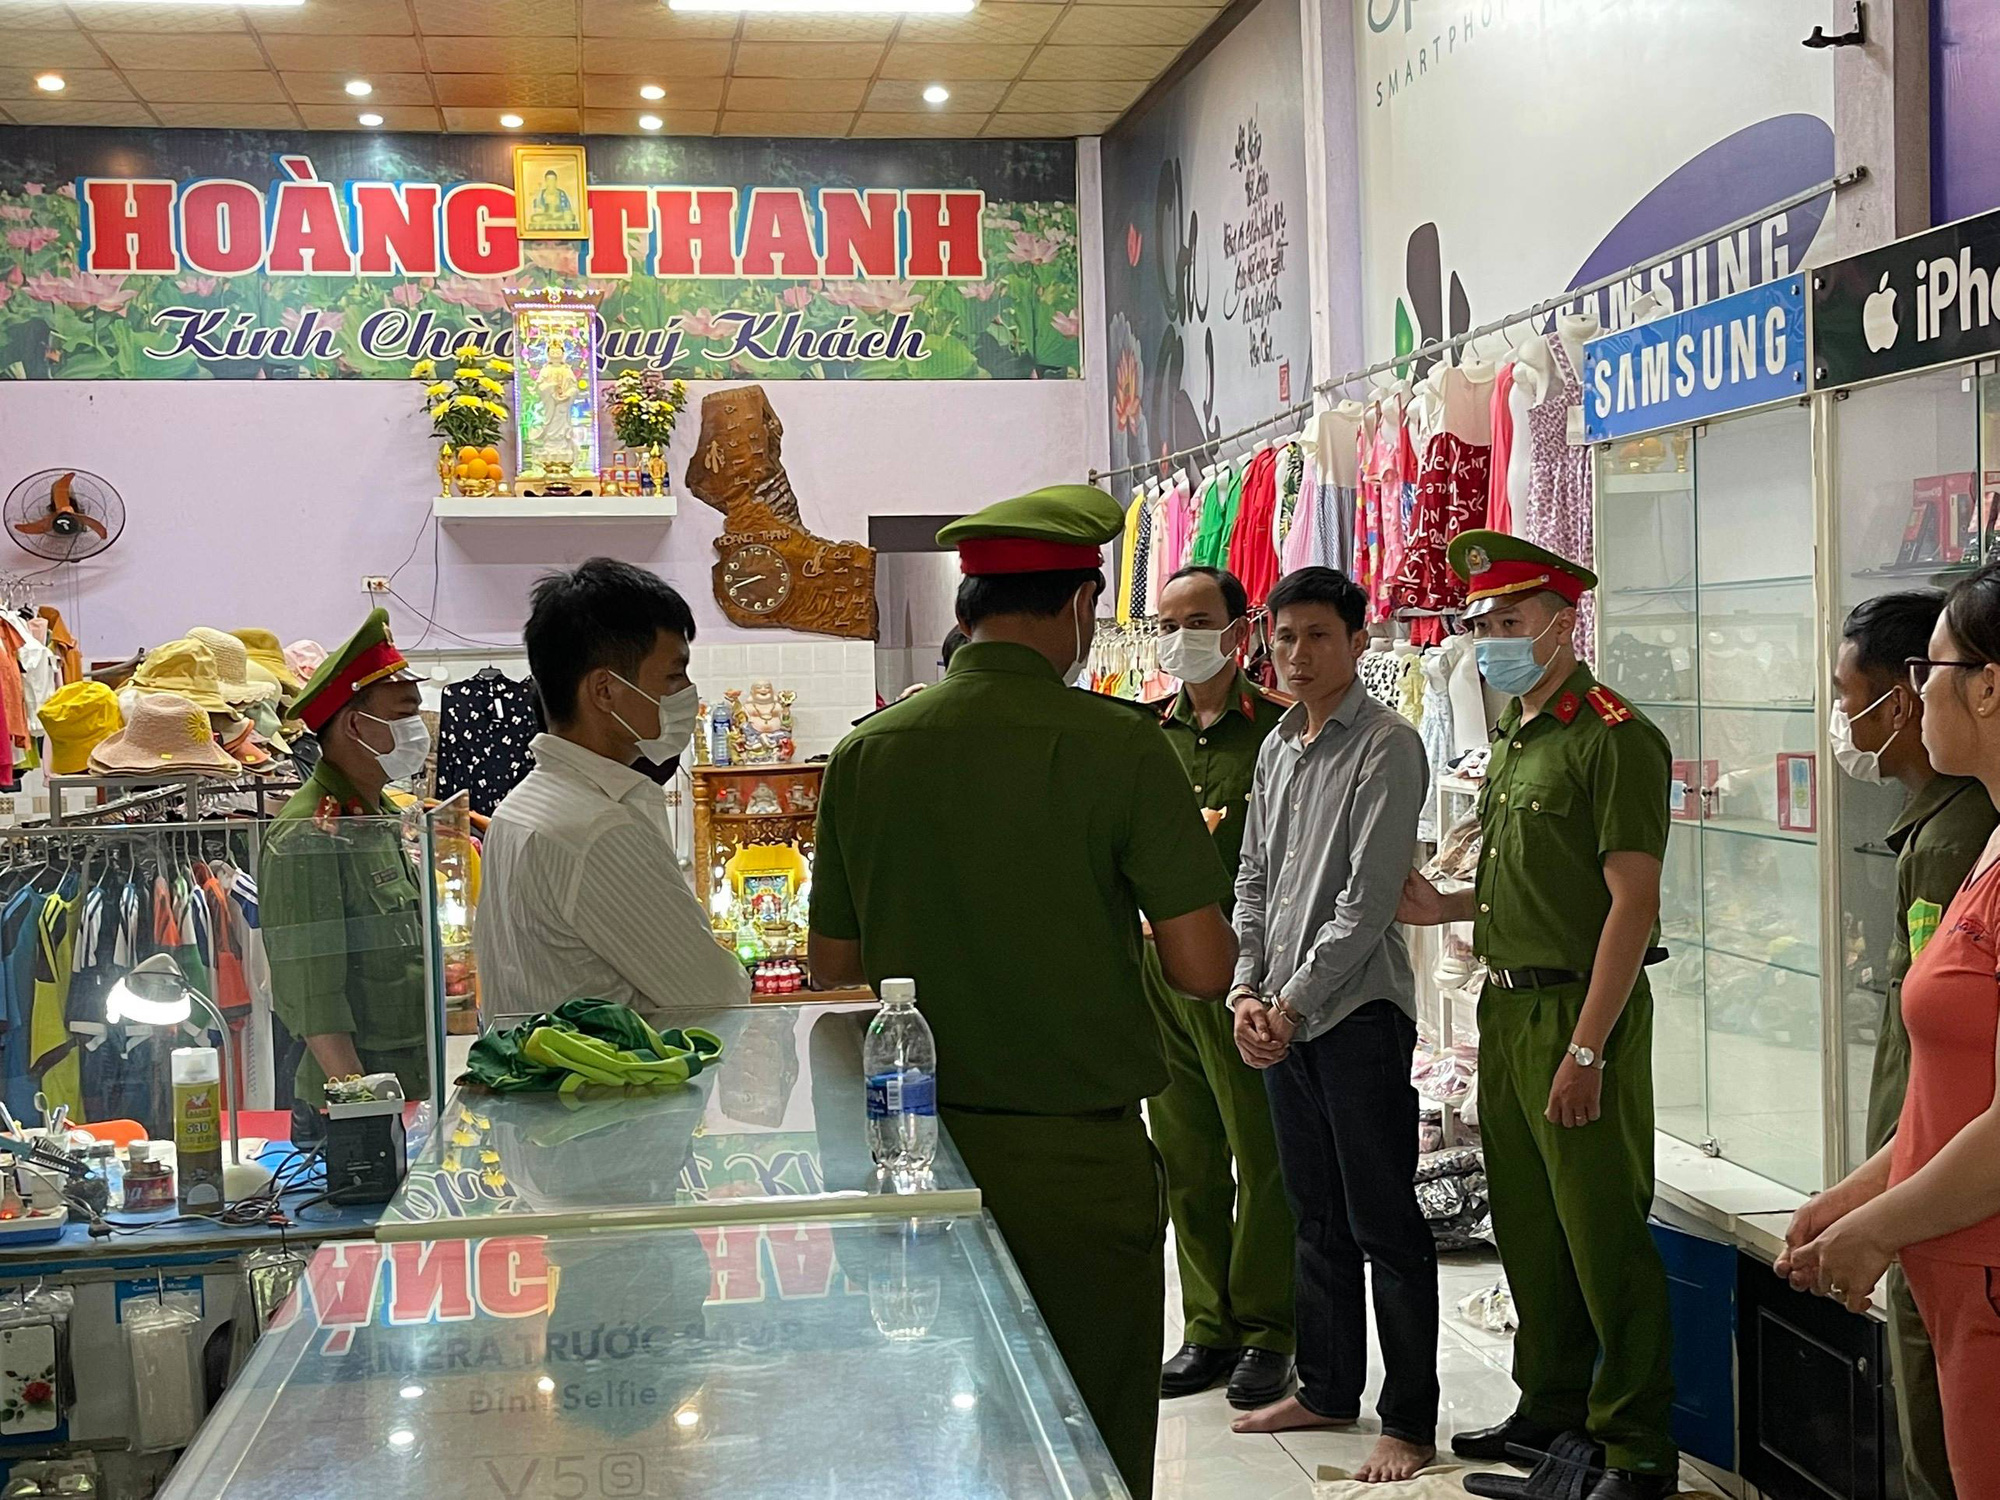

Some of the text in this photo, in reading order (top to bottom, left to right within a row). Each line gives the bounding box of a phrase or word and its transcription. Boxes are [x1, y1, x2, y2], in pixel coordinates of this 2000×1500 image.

[82, 153, 987, 280] HOÀNG THANH
[1916, 246, 2000, 342] iPh
[144, 306, 342, 361] Kính
[597, 311, 690, 371] uý
[701, 310, 932, 362] Khách
[1594, 305, 1786, 418] SAMSUNG
[729, 562, 739, 571] 10
[775, 559, 783, 567] 2
[724, 574, 733, 583] 9
[781, 573, 789, 581] 3
[729, 588, 737, 596] 8
[740, 598, 748, 607] 7
[754, 602, 762, 610] 6
[562, 1378, 658, 1411] Selfie
